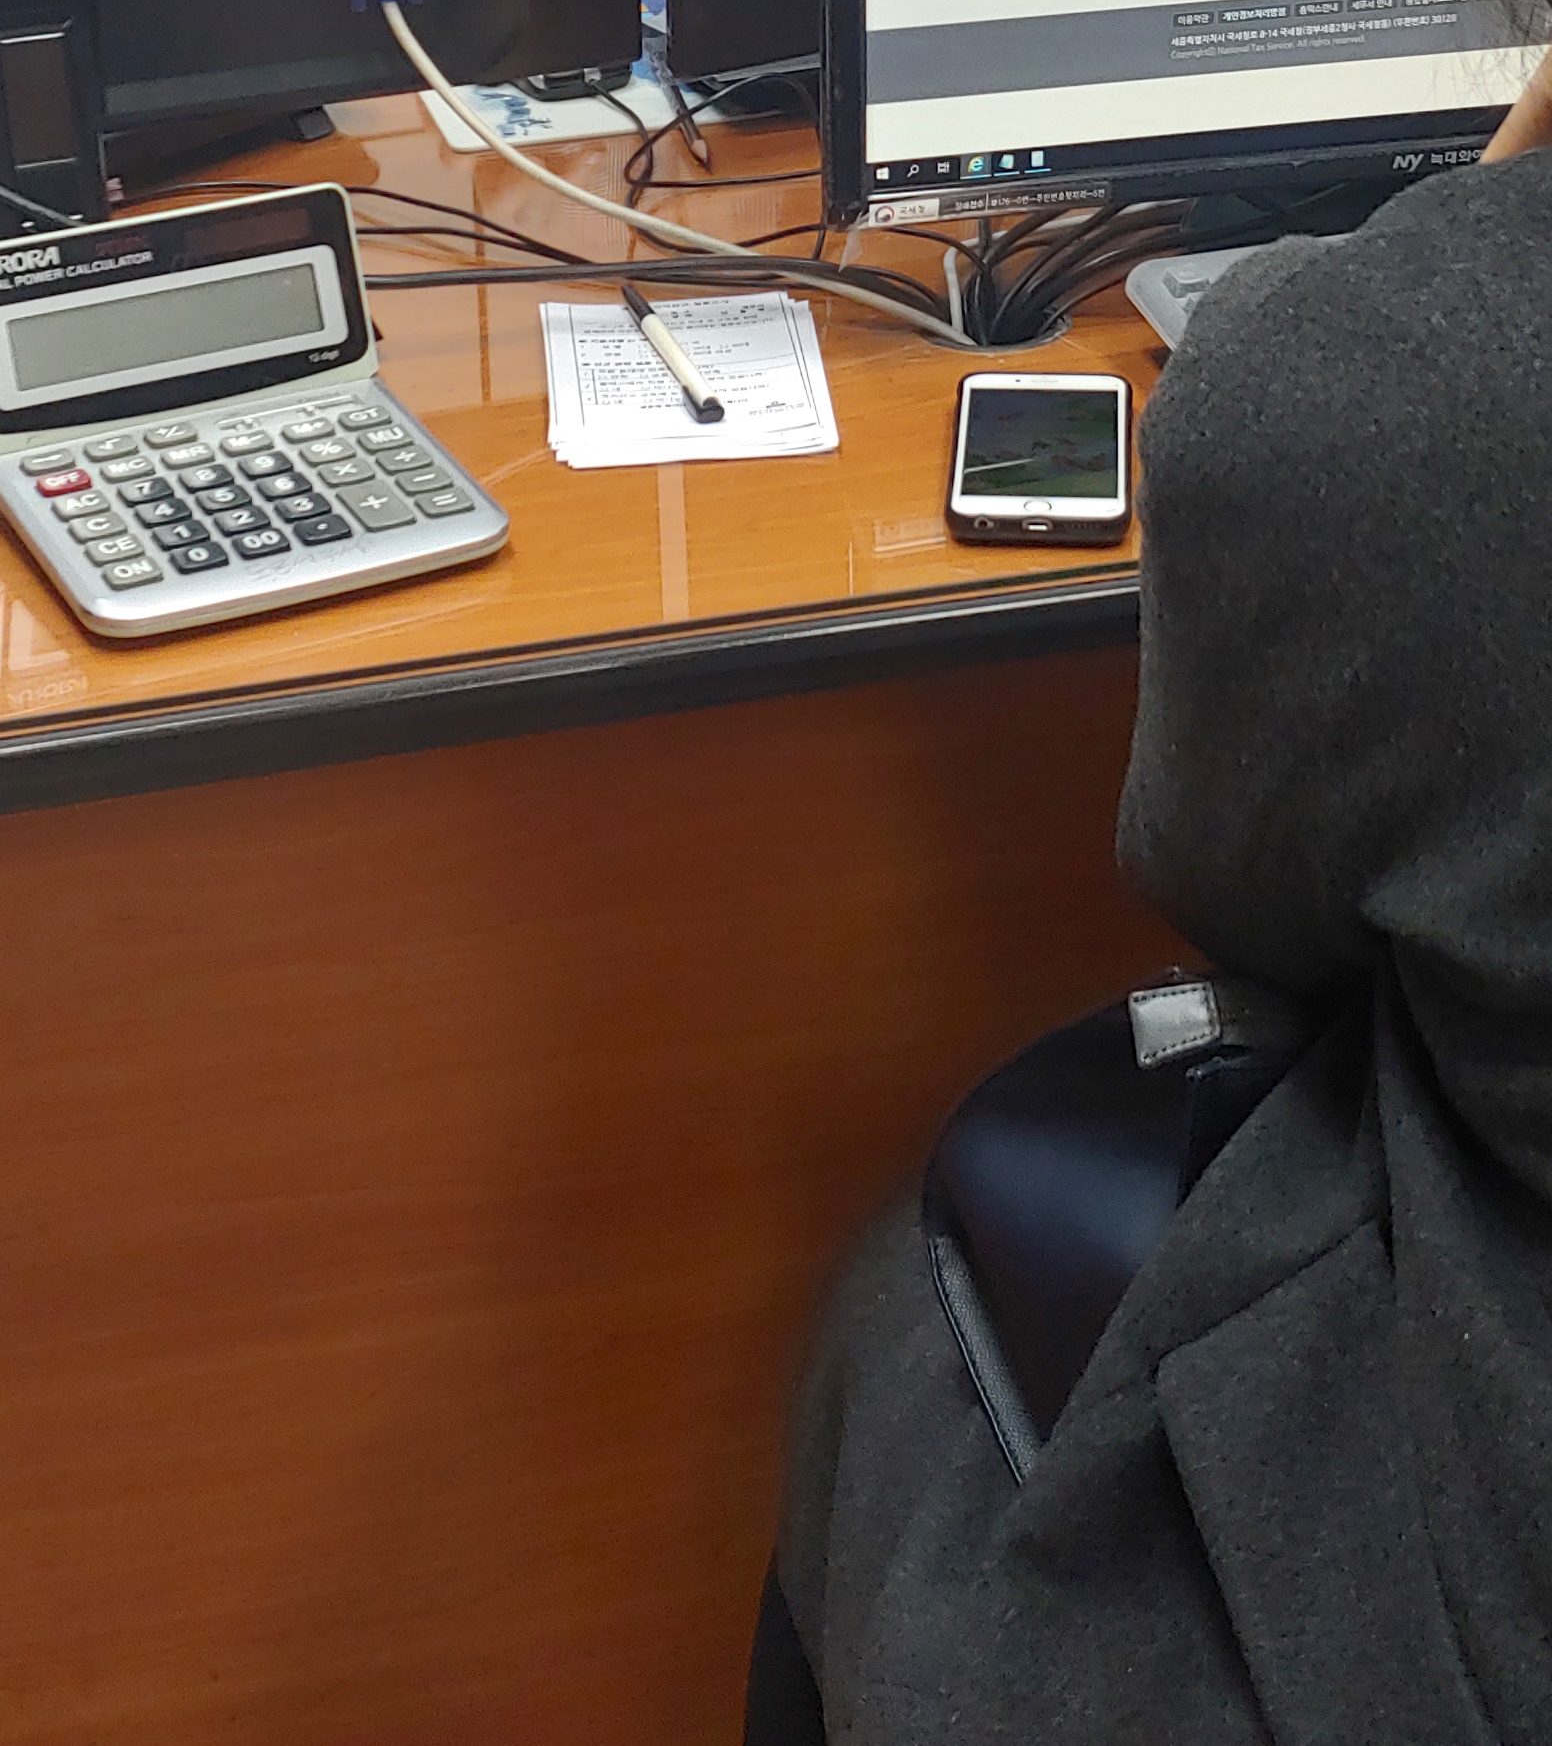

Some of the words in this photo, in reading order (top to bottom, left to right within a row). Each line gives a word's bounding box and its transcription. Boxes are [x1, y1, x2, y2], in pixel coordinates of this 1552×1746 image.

[14, 267, 65, 288] POWER
[65, 250, 155, 278] CALCULATOR
[108, 458, 147, 474] MC
[254, 455, 276, 469] 9
[45, 471, 80, 487] OFF
[195, 467, 217, 482] 8
[134, 480, 152, 495] 7
[273, 476, 296, 491] 6
[66, 492, 100, 510] AC
[215, 488, 236, 503] 5
[154, 503, 176, 518] 4
[293, 497, 315, 512] 3
[86, 517, 109, 532] C
[232, 510, 256, 526] 2
[172, 525, 192, 539] 1
[242, 530, 281, 549] 00
[98, 536, 138, 555] CE
[113, 560, 154, 579] ON
